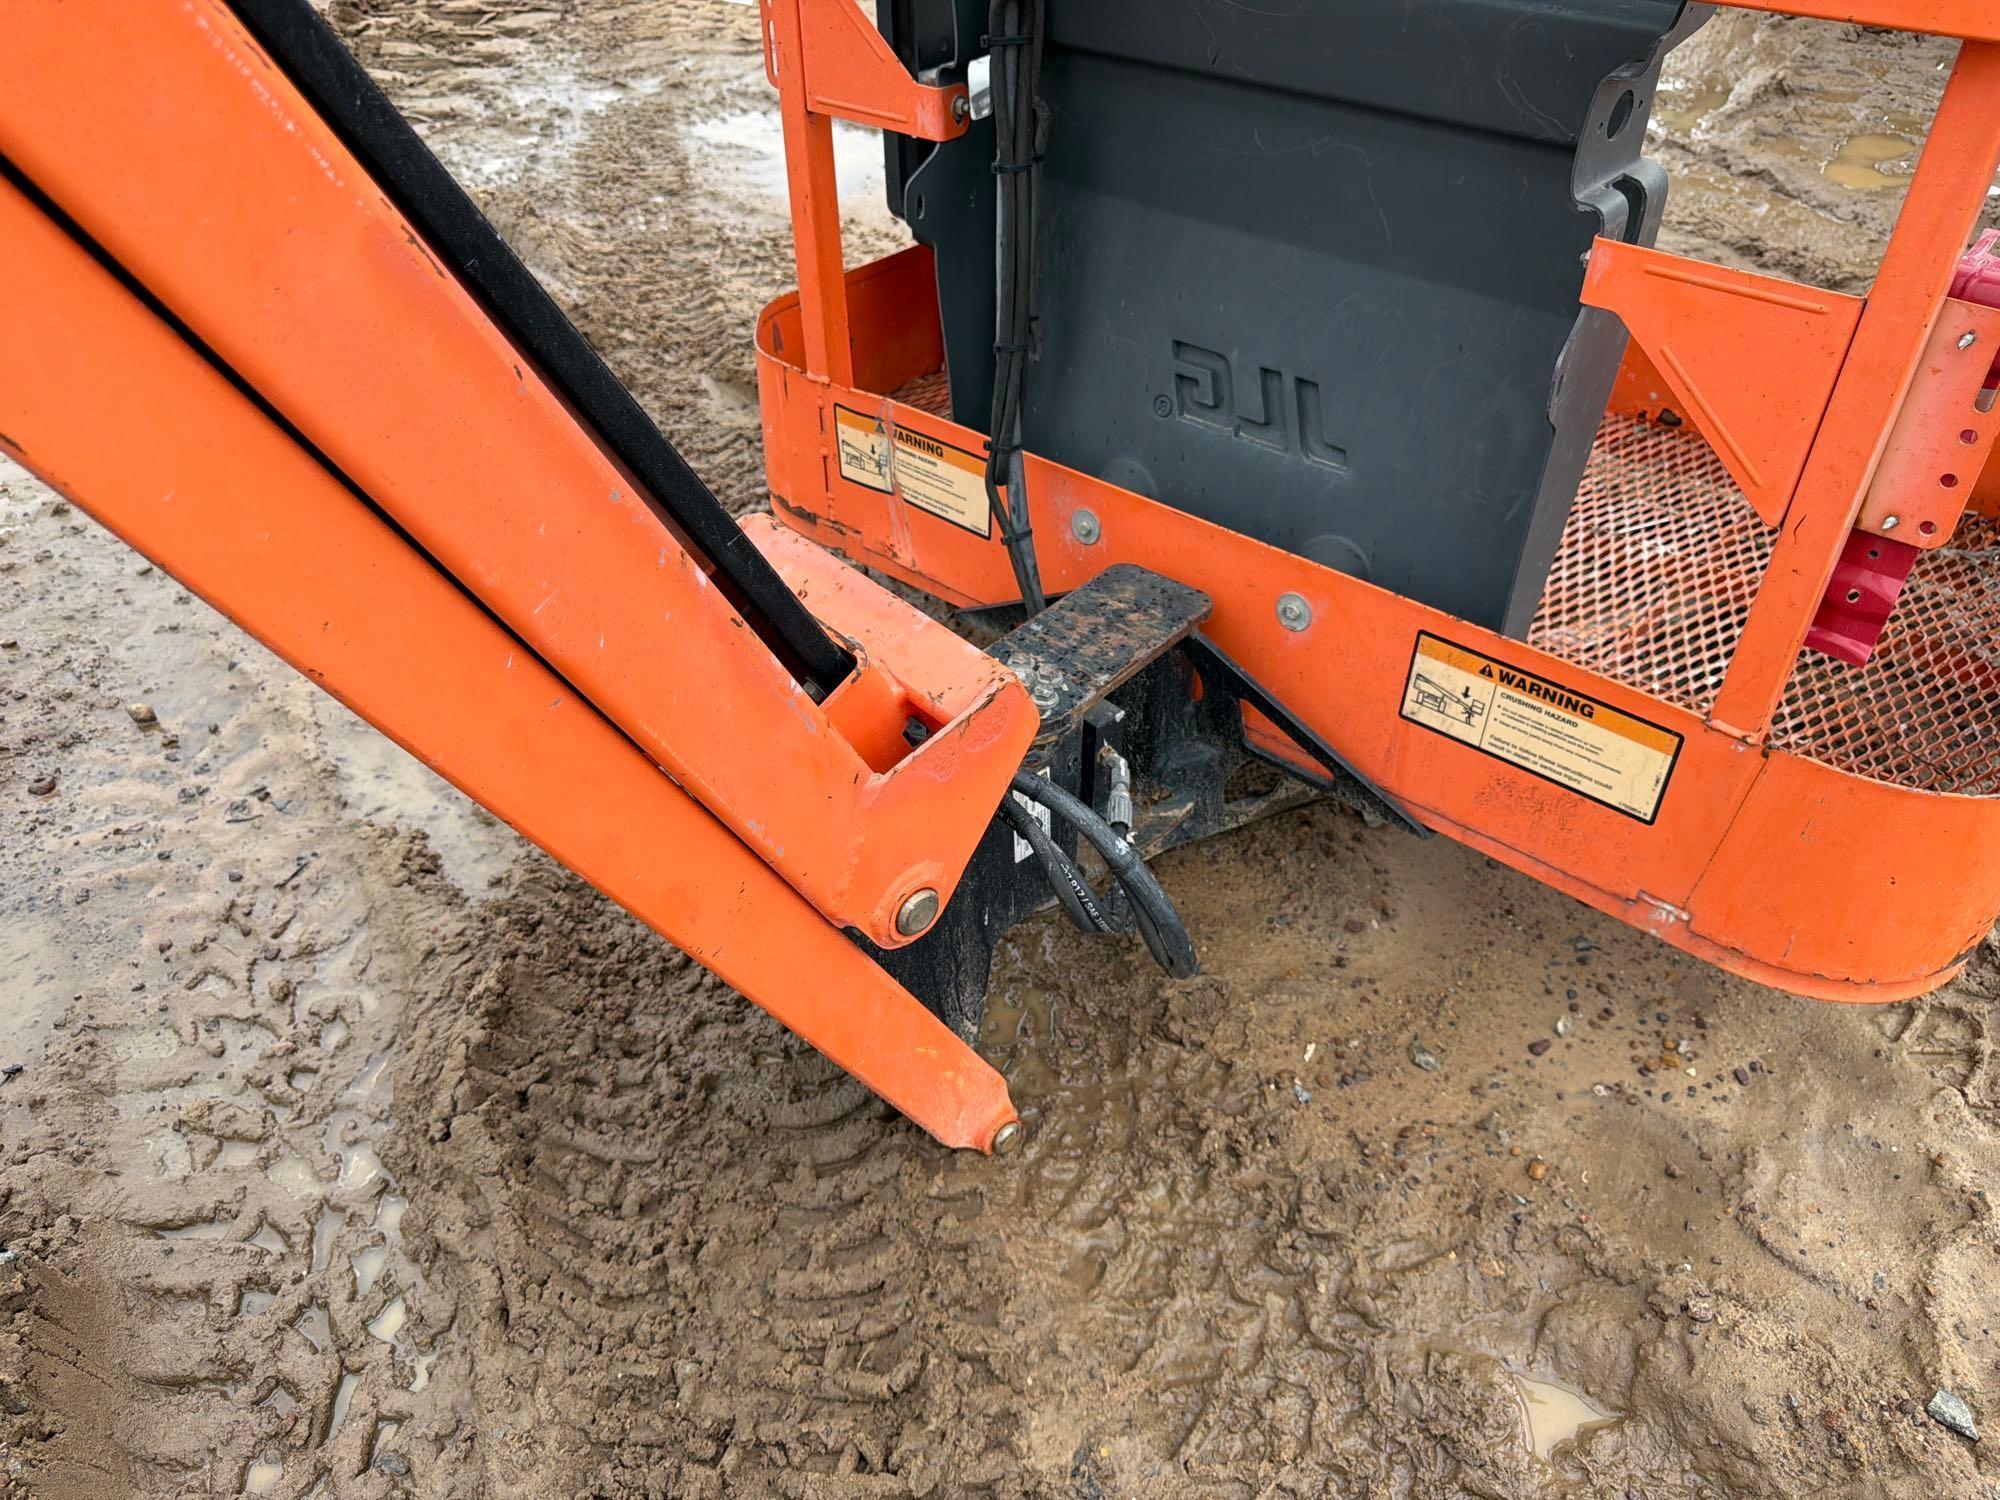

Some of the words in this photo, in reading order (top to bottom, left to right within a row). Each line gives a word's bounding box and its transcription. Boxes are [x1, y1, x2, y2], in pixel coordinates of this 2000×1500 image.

[1499, 669, 1594, 719] WARNING
[1501, 692, 1542, 713] CRUSHING
[1544, 710, 1578, 728] HAZARD
